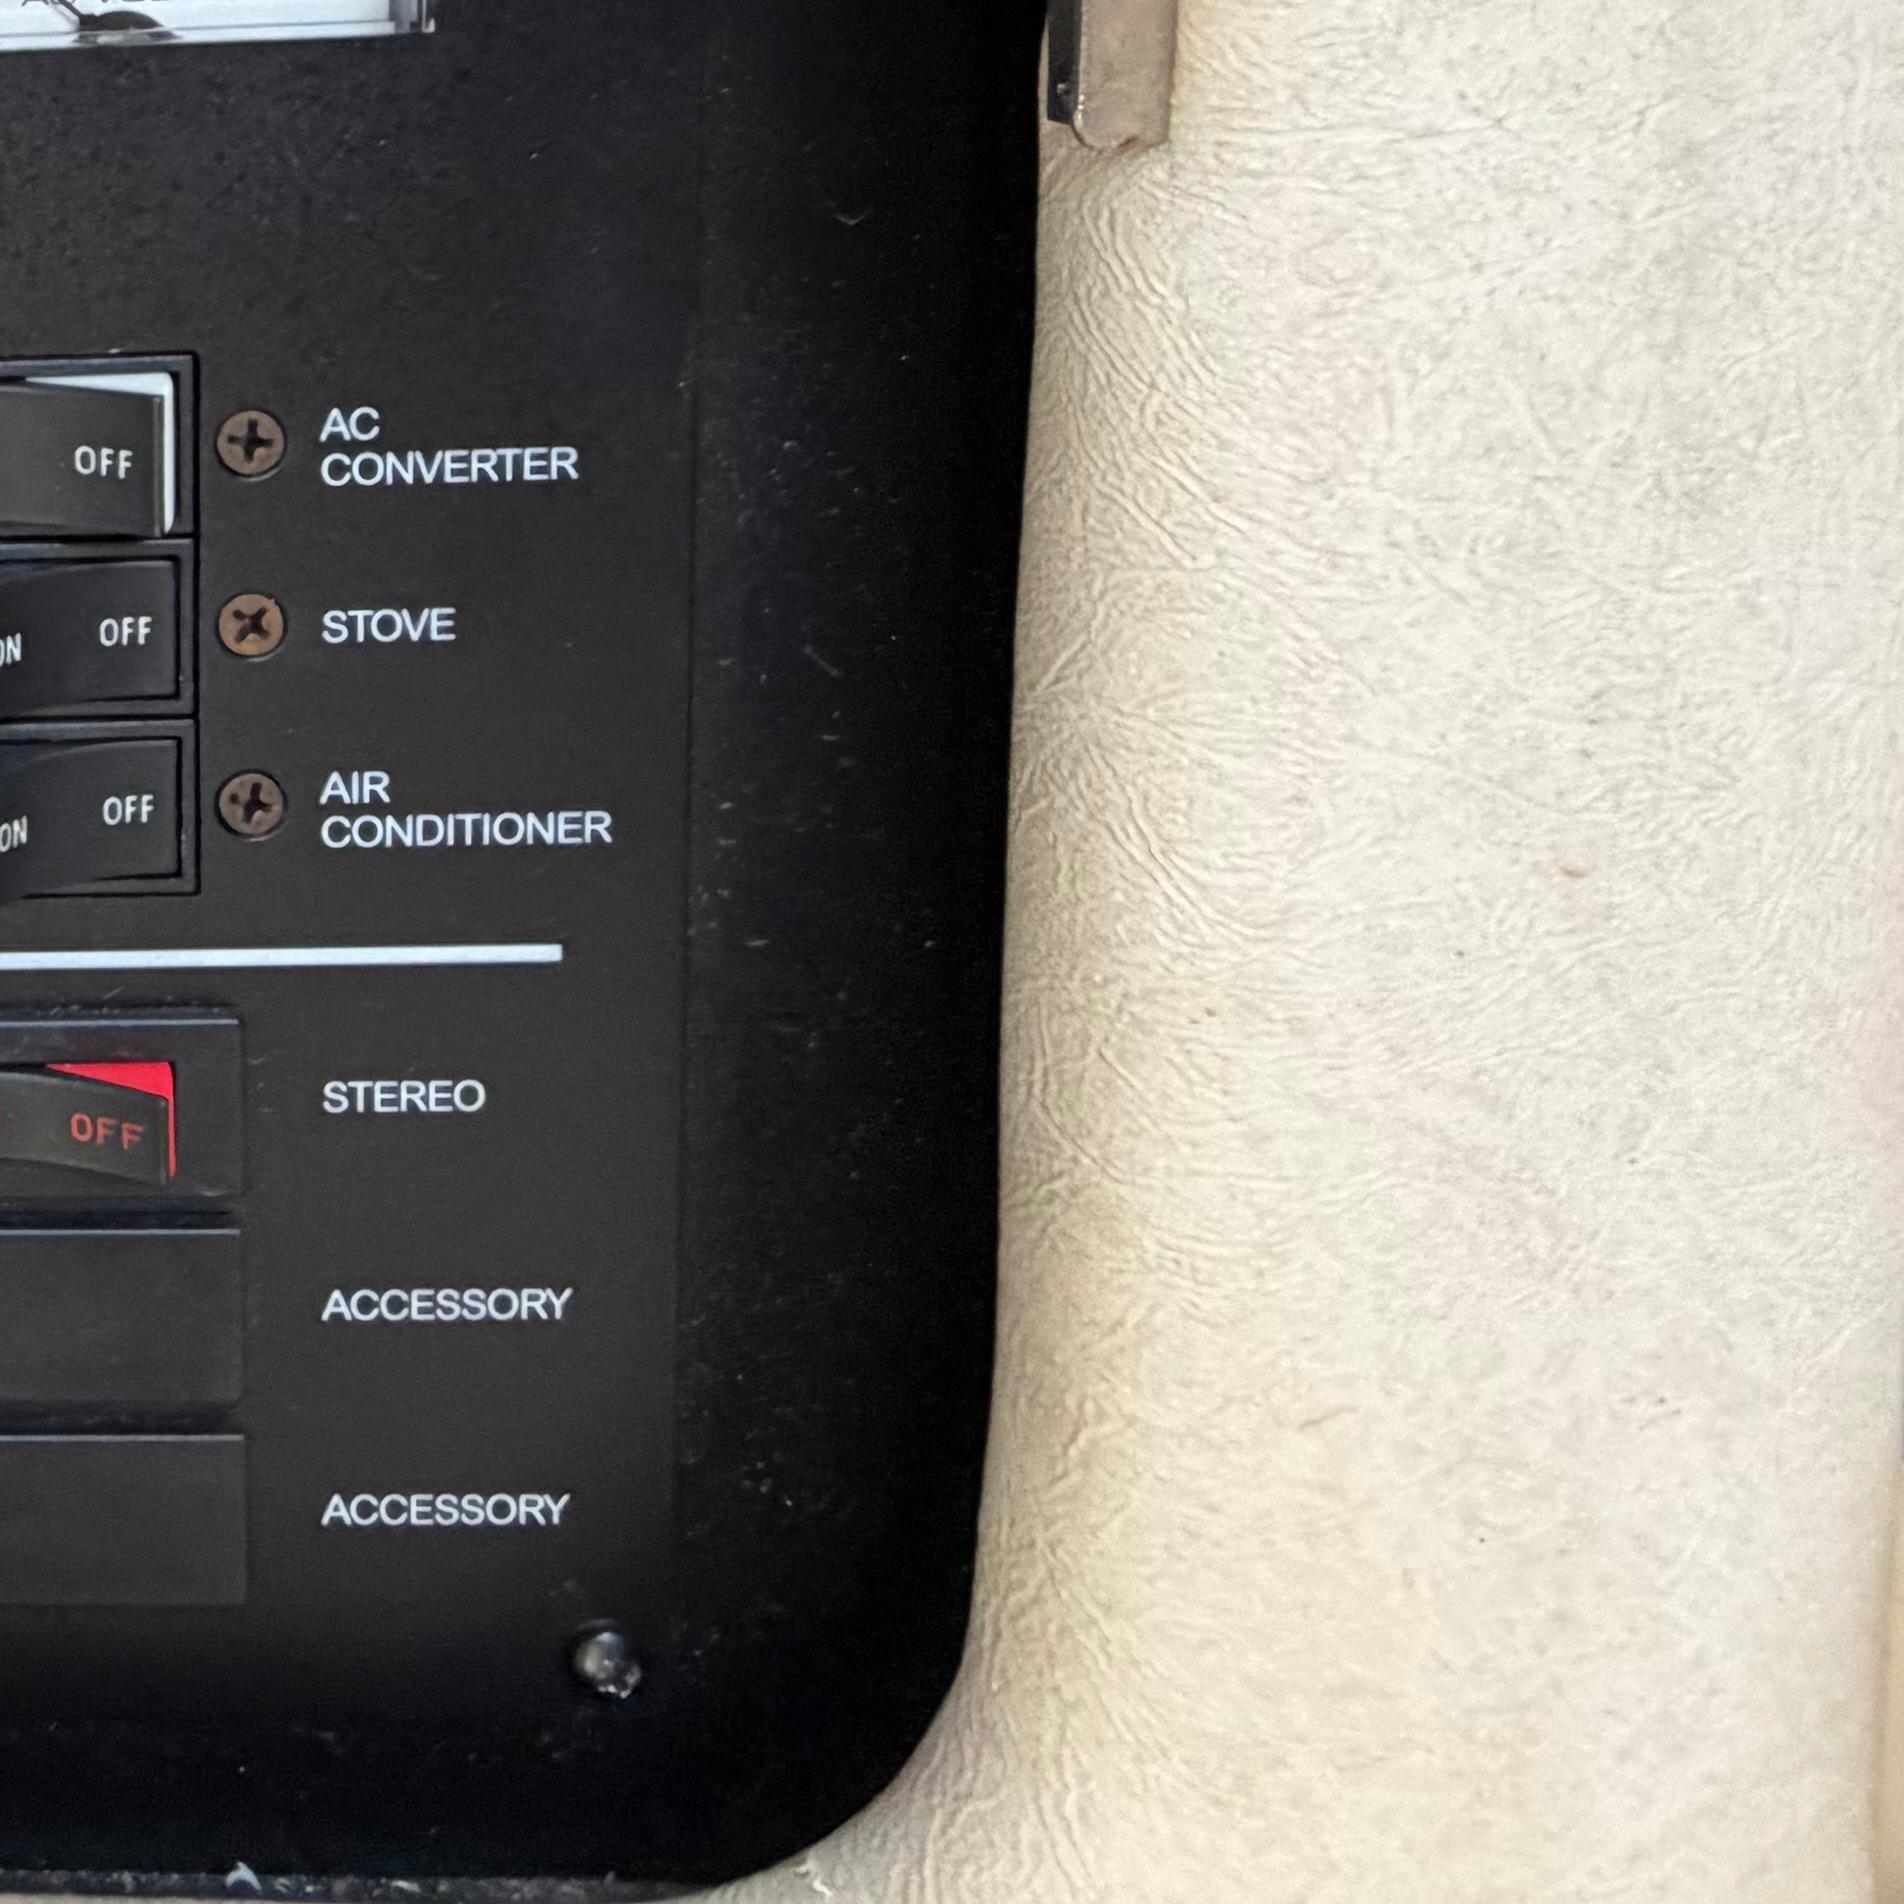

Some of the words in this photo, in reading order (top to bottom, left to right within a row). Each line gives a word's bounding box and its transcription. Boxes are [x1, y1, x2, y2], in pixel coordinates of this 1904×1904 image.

[320, 407, 381, 443] AC
[74, 446, 134, 480] OFF
[321, 446, 580, 487] CONVERTER
[99, 616, 153, 648] OFF
[322, 608, 457, 644] STOVE
[320, 771, 391, 807] AIR
[102, 794, 155, 826] OFF
[321, 810, 612, 851] CONDITIONER
[322, 1078, 486, 1114] STEREO
[69, 1113, 144, 1152] OFF
[321, 1287, 573, 1323] ACCESSORY
[321, 1494, 571, 1527] ACCESSORY
